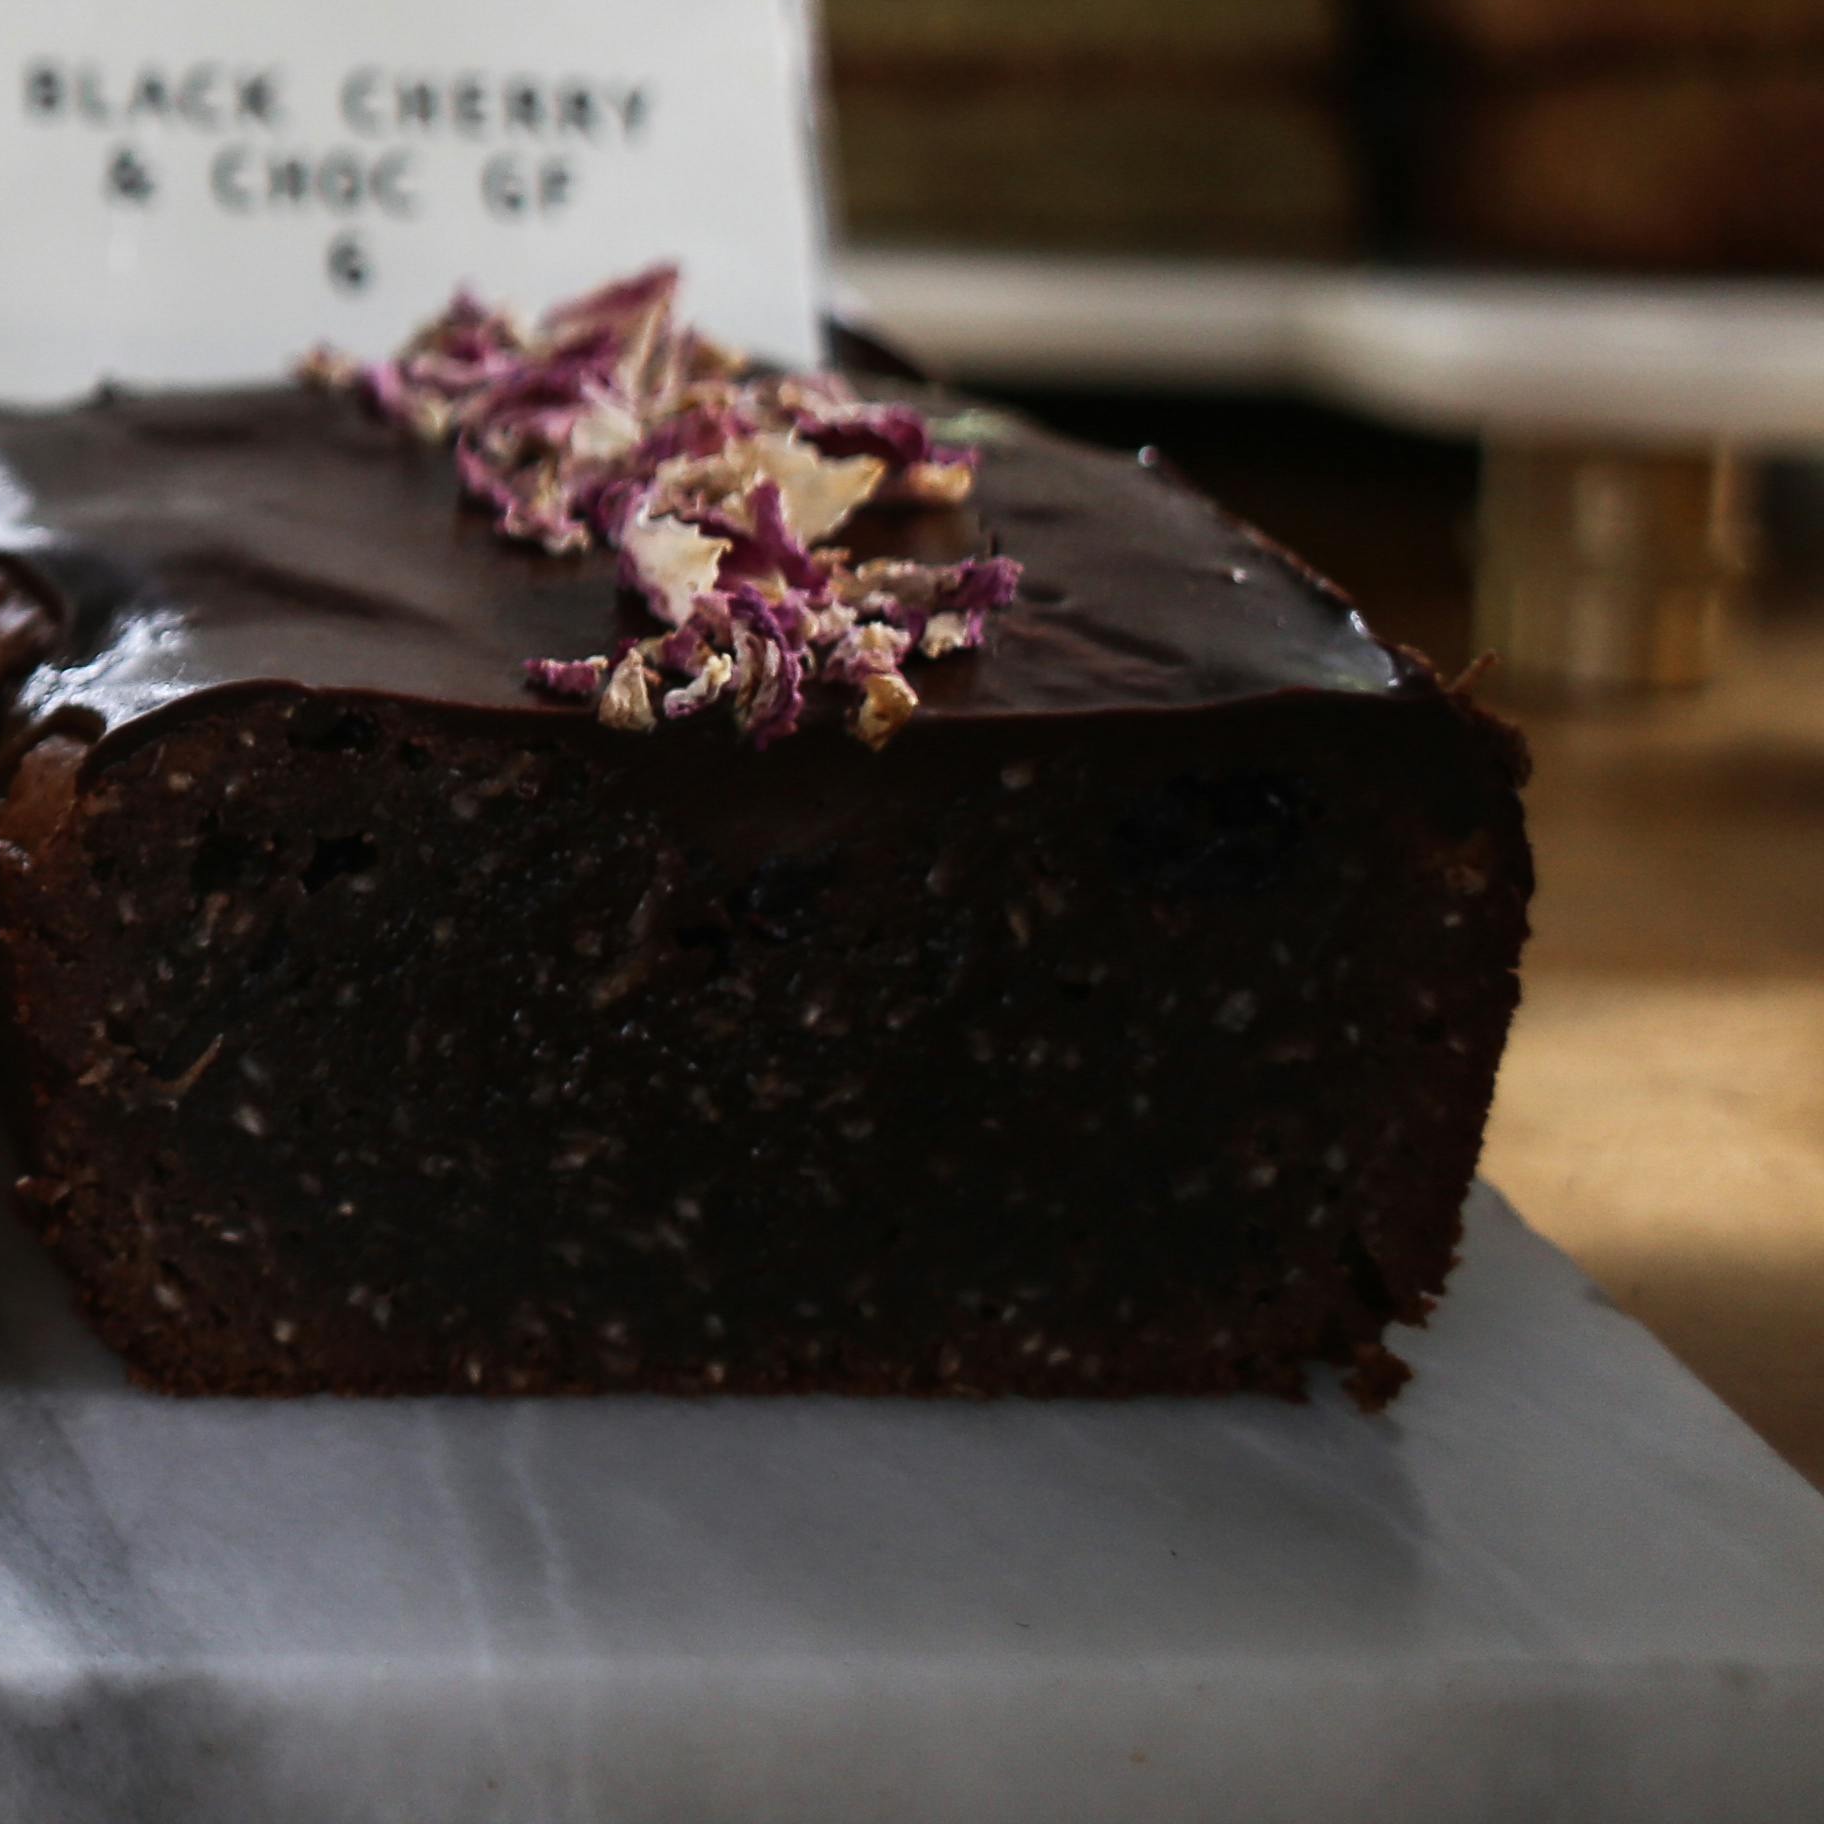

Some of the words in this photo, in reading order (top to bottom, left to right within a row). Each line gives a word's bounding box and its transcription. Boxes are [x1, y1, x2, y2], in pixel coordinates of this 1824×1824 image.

[22, 60, 282, 124] BLACK
[340, 68, 654, 134] CHERRY
[106, 146, 156, 209] &
[211, 151, 414, 214] CHOC
